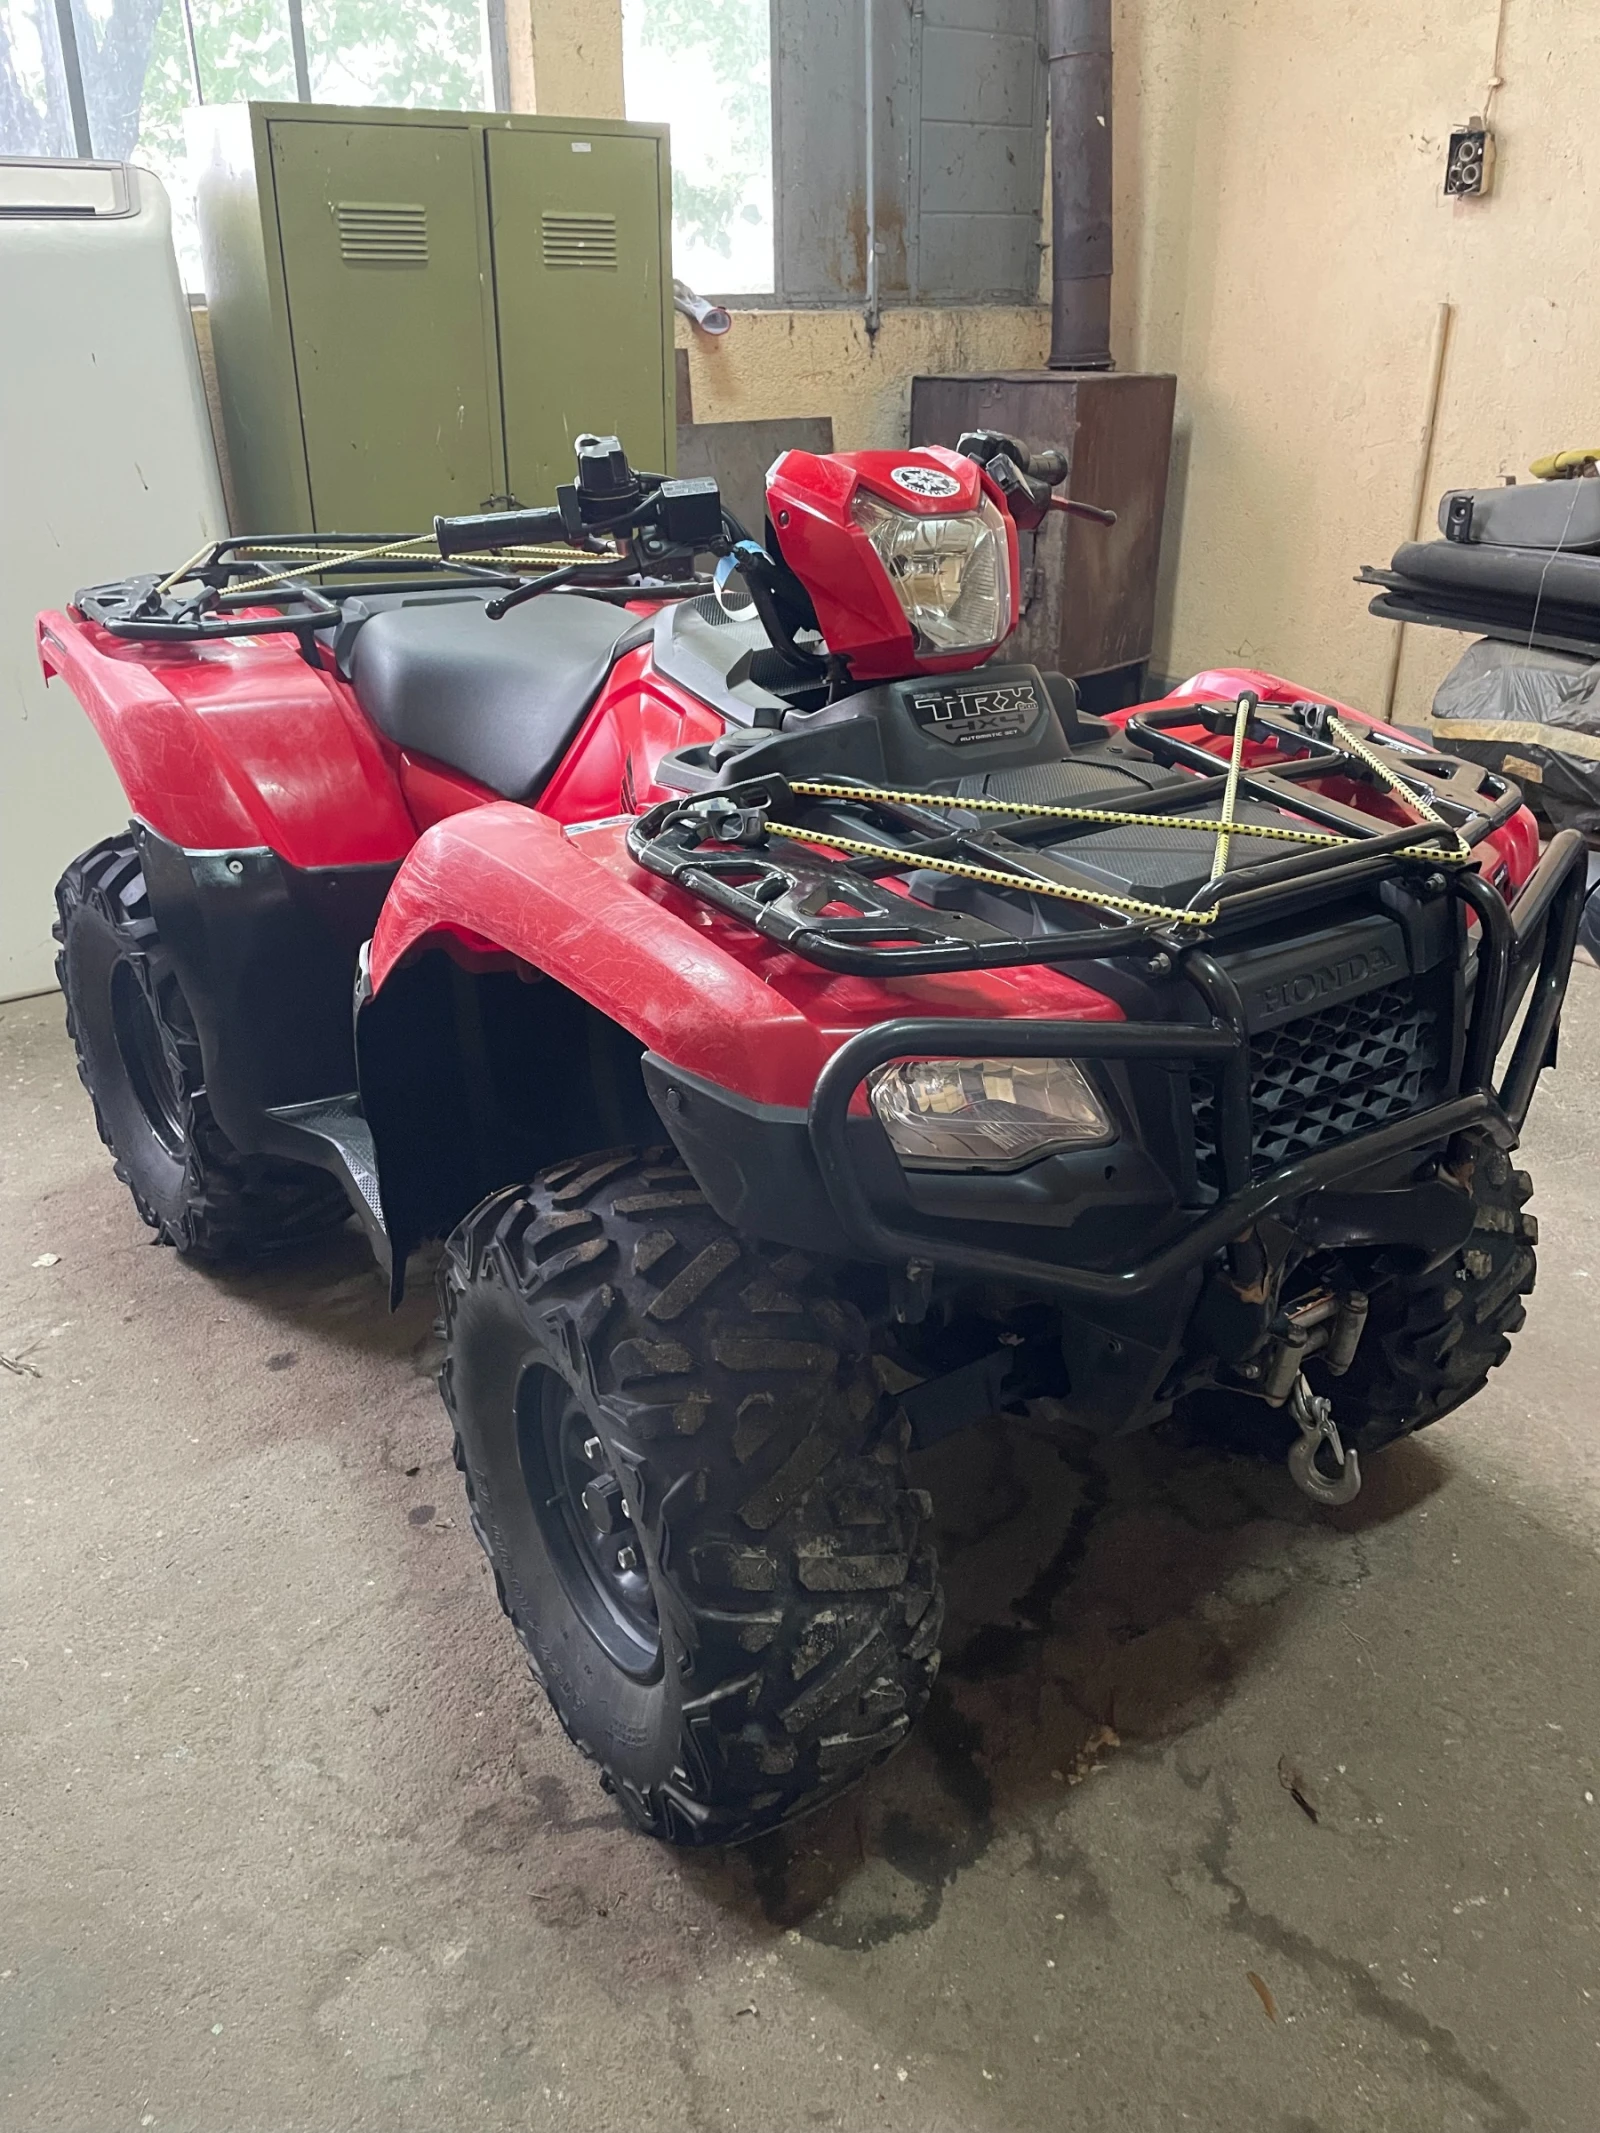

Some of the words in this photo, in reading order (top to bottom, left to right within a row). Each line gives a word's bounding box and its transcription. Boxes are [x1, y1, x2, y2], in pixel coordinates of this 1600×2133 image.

[914, 686, 1038, 721] TRX
[959, 731, 1003, 742] AUTOMATIC
[1255, 945, 1398, 1018] HONDA
